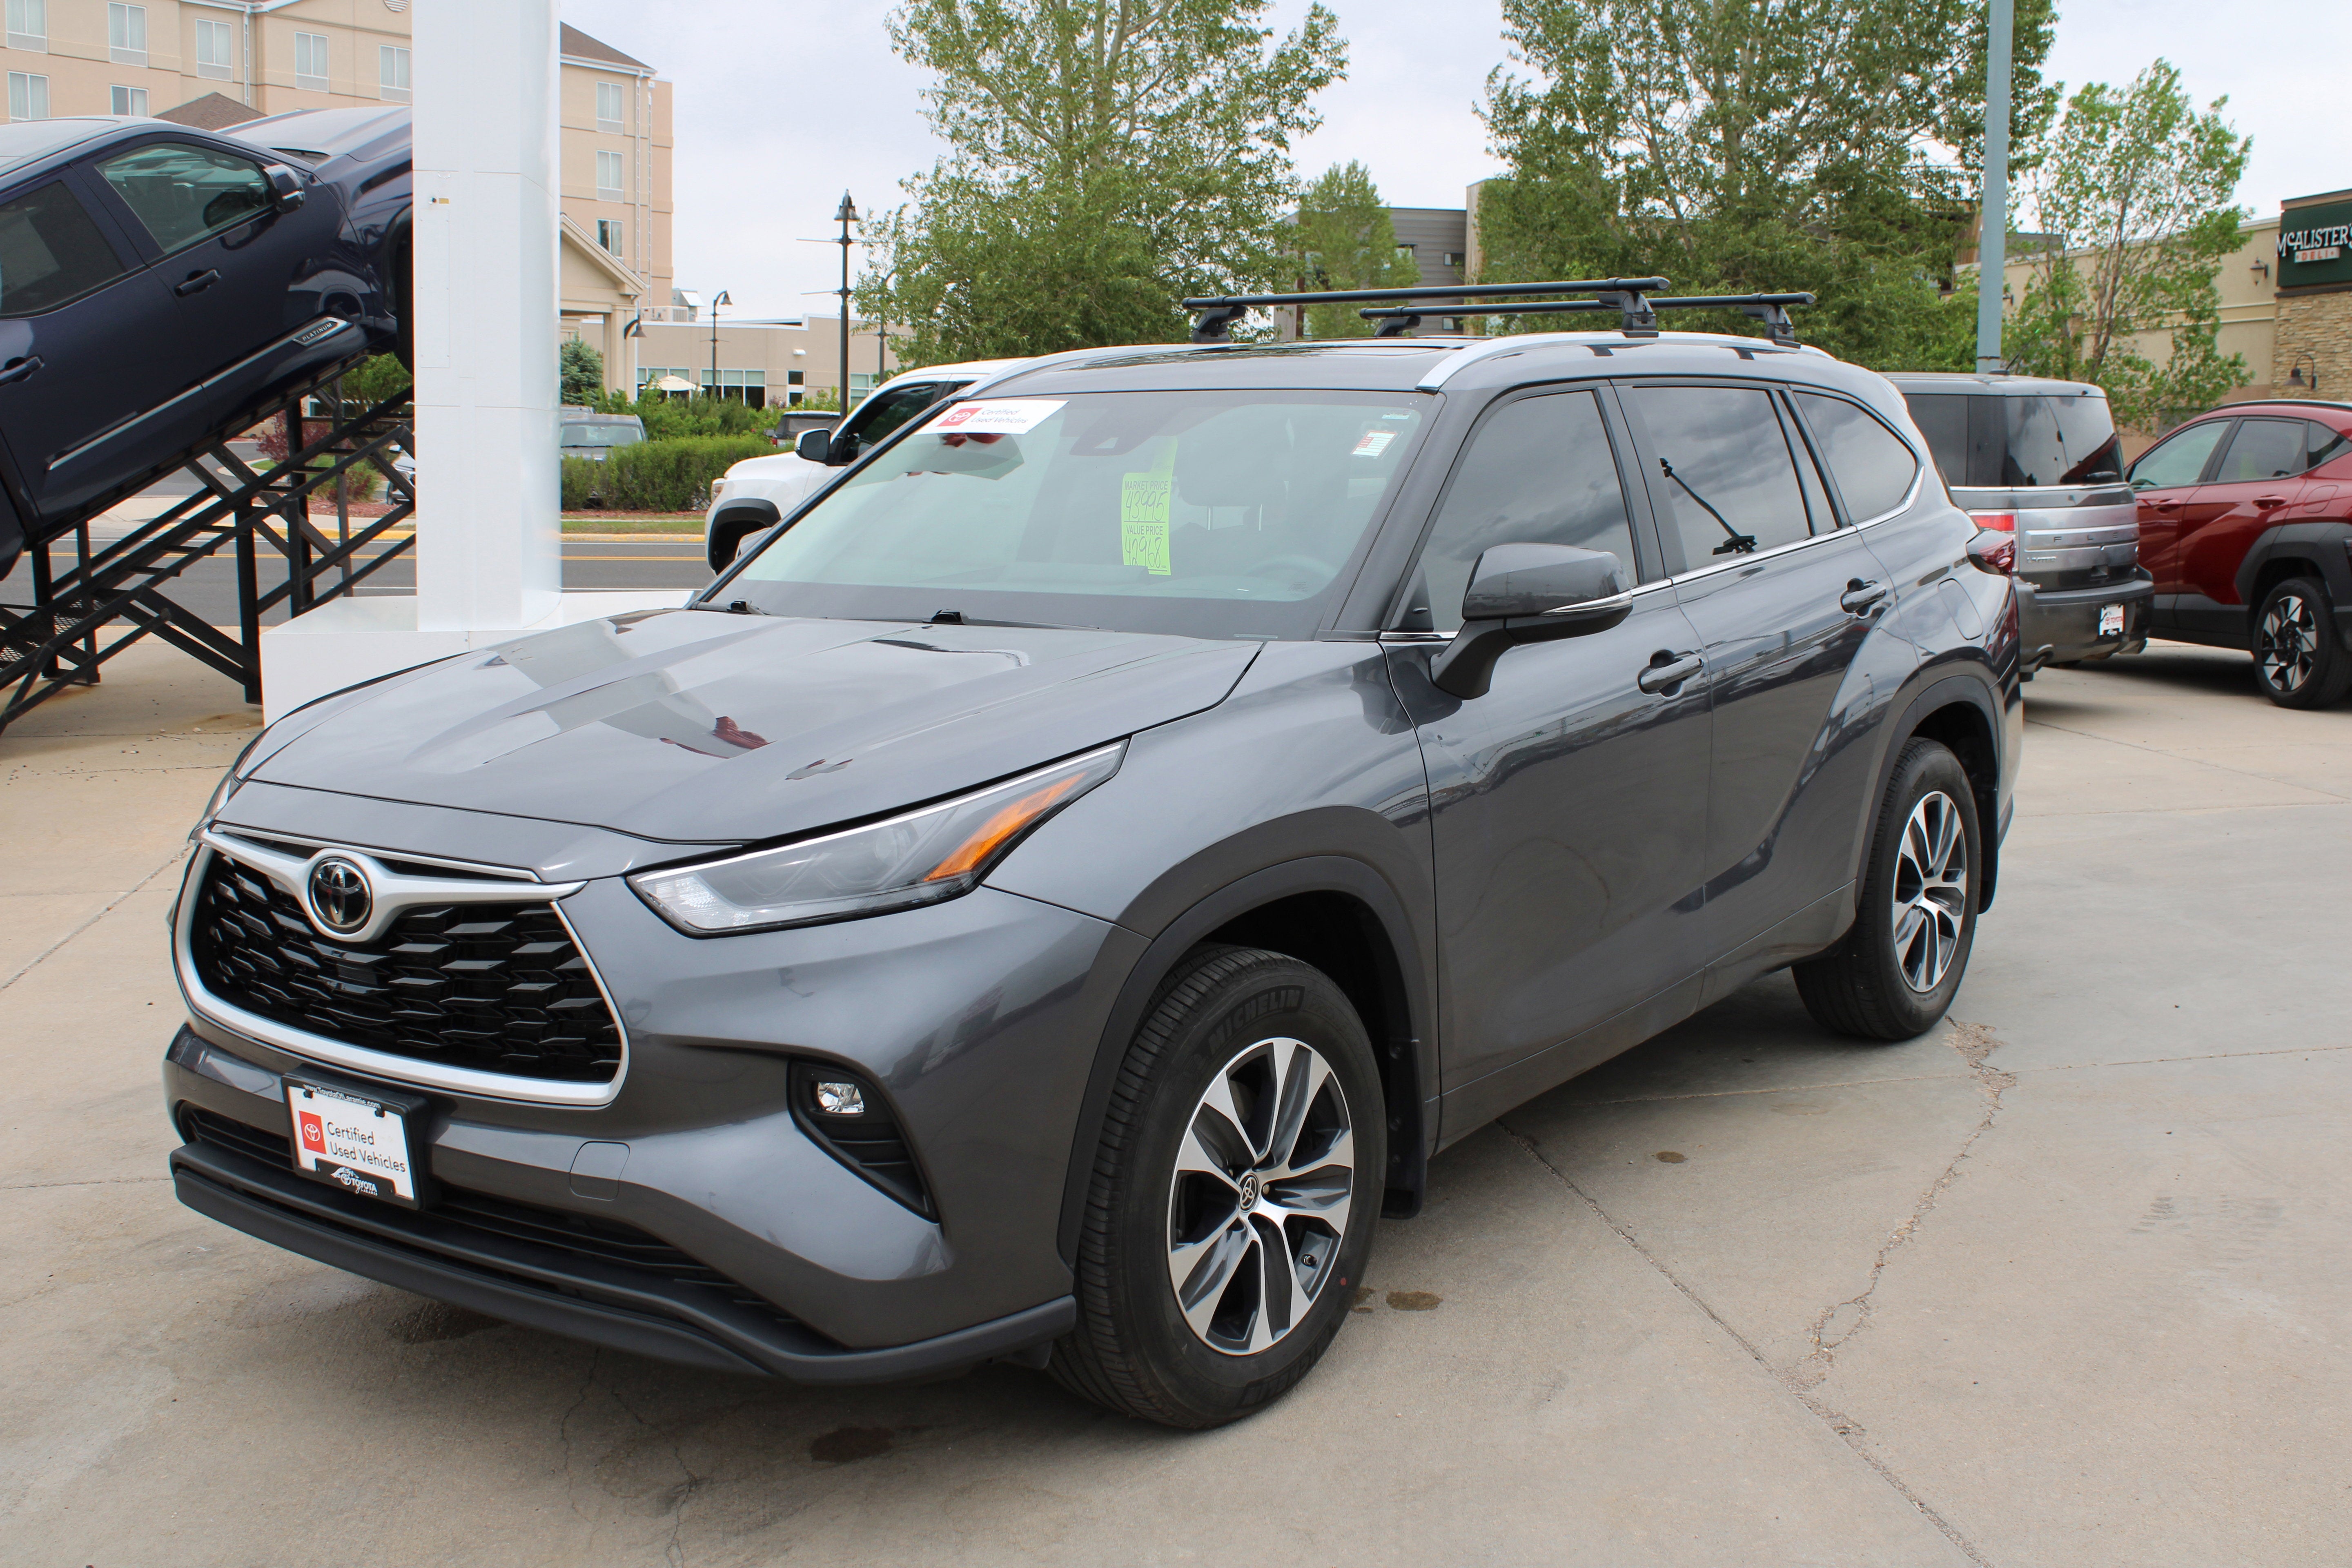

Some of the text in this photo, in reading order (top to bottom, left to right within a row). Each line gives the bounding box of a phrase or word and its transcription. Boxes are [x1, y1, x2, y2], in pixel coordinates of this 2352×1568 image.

[2302, 249, 2328, 261] DELI
[302, 323, 332, 341] PLATINUM
[1125, 481, 1168, 490] MARKET PRICE
[1126, 490, 1168, 524] 43,995
[1127, 525, 1163, 535] VALUE PRICE
[2054, 532, 2119, 542] FLE
[1208, 990, 1300, 1055] MICHELIN
[303, 1084, 381, 1109] www.ToyotaOfLaramie.com
[327, 1122, 375, 1145] Certified
[330, 1141, 406, 1172] Used Vehicles
[351, 1177, 377, 1192] TOYOTA
